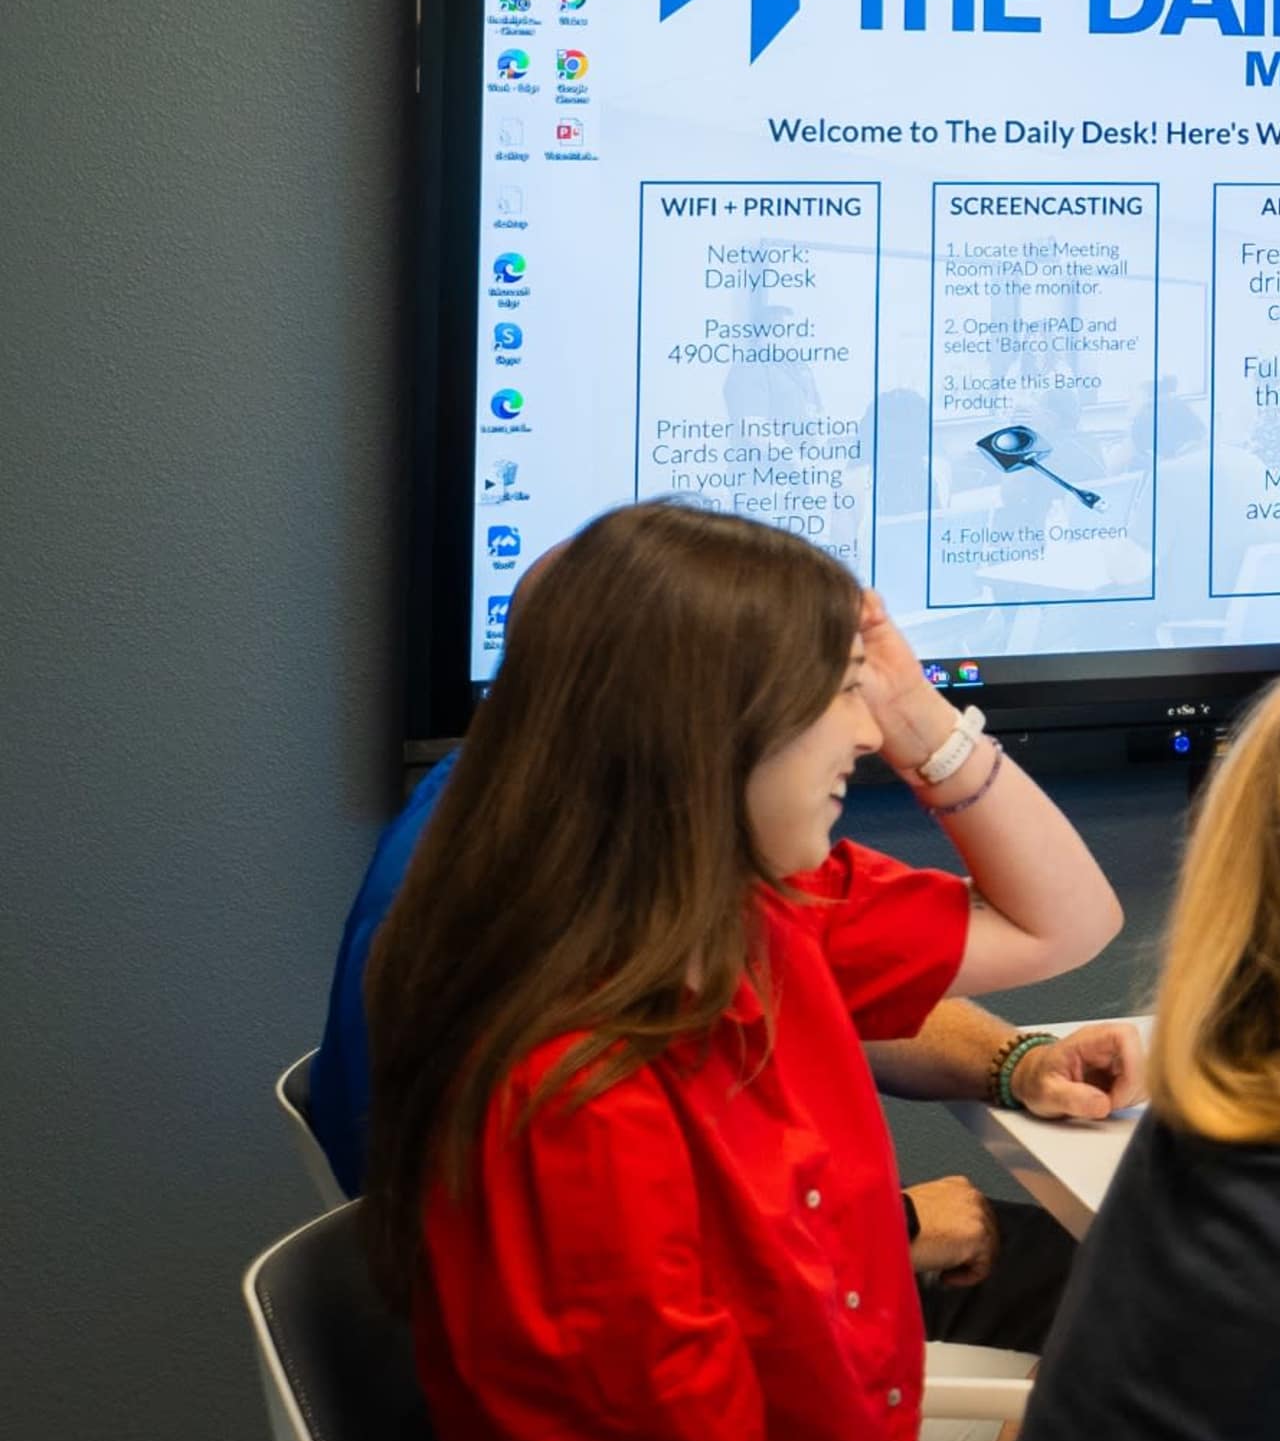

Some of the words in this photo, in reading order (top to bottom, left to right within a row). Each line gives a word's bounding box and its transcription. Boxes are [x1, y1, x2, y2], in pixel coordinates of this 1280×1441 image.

[769, 118, 901, 143] Welcome
[911, 123, 938, 143] to
[946, 120, 996, 143] The
[1005, 120, 1075, 149] Daily
[1082, 120, 1157, 144] Desk!
[1167, 122, 1249, 145] Here's
[661, 197, 716, 216] WIFI
[725, 201, 738, 215] +
[744, 198, 862, 216] PRINTING
[950, 197, 1143, 215] SCREENCASTING
[708, 244, 809, 264] Network:
[946, 243, 960, 258] 1.
[965, 243, 1018, 258] Locate
[1023, 243, 1049, 257] the
[1054, 242, 1120, 260] Meeting
[946, 262, 993, 277] Room
[997, 261, 1038, 276] iPAD
[1042, 263, 1062, 276] on
[1066, 261, 1093, 275] the
[1097, 261, 1128, 275] wall
[705, 269, 816, 292] DailyDesk
[945, 283, 979, 296] next
[984, 282, 1000, 295] to
[1006, 281, 1032, 295] the
[1036, 281, 1102, 295] monitor.
[705, 318, 815, 339] Password:
[944, 320, 958, 334] 2.
[963, 319, 1008, 336] Open
[1013, 318, 1040, 333] the
[1043, 318, 1083, 332] iPAD
[1088, 318, 1117, 332] and
[668, 344, 849, 364] 490Chadbourne
[944, 338, 992, 353] select
[944, 376, 958, 391] 3.
[963, 375, 1016, 390] Locate
[1021, 375, 1050, 389] this
[1055, 374, 1101, 388] Barco
[657, 420, 734, 439] Printer
[741, 417, 858, 437] Instruction
[652, 444, 718, 465] Cards
[723, 447, 760, 463] can
[768, 443, 793, 462] be
[799, 440, 861, 460] found
[672, 470, 690, 488] in
[697, 472, 746, 492] your
[753, 466, 843, 488] Meeting
[733, 492, 777, 513] Feel
[784, 493, 827, 510] free
[834, 494, 855, 510] to
[772, 515, 824, 534] TDD
[941, 530, 956, 545] 4.
[961, 528, 1015, 543] Follow
[1018, 527, 1045, 541] the
[1050, 525, 1127, 541] Onscreen
[941, 548, 1045, 563] Instructions!
